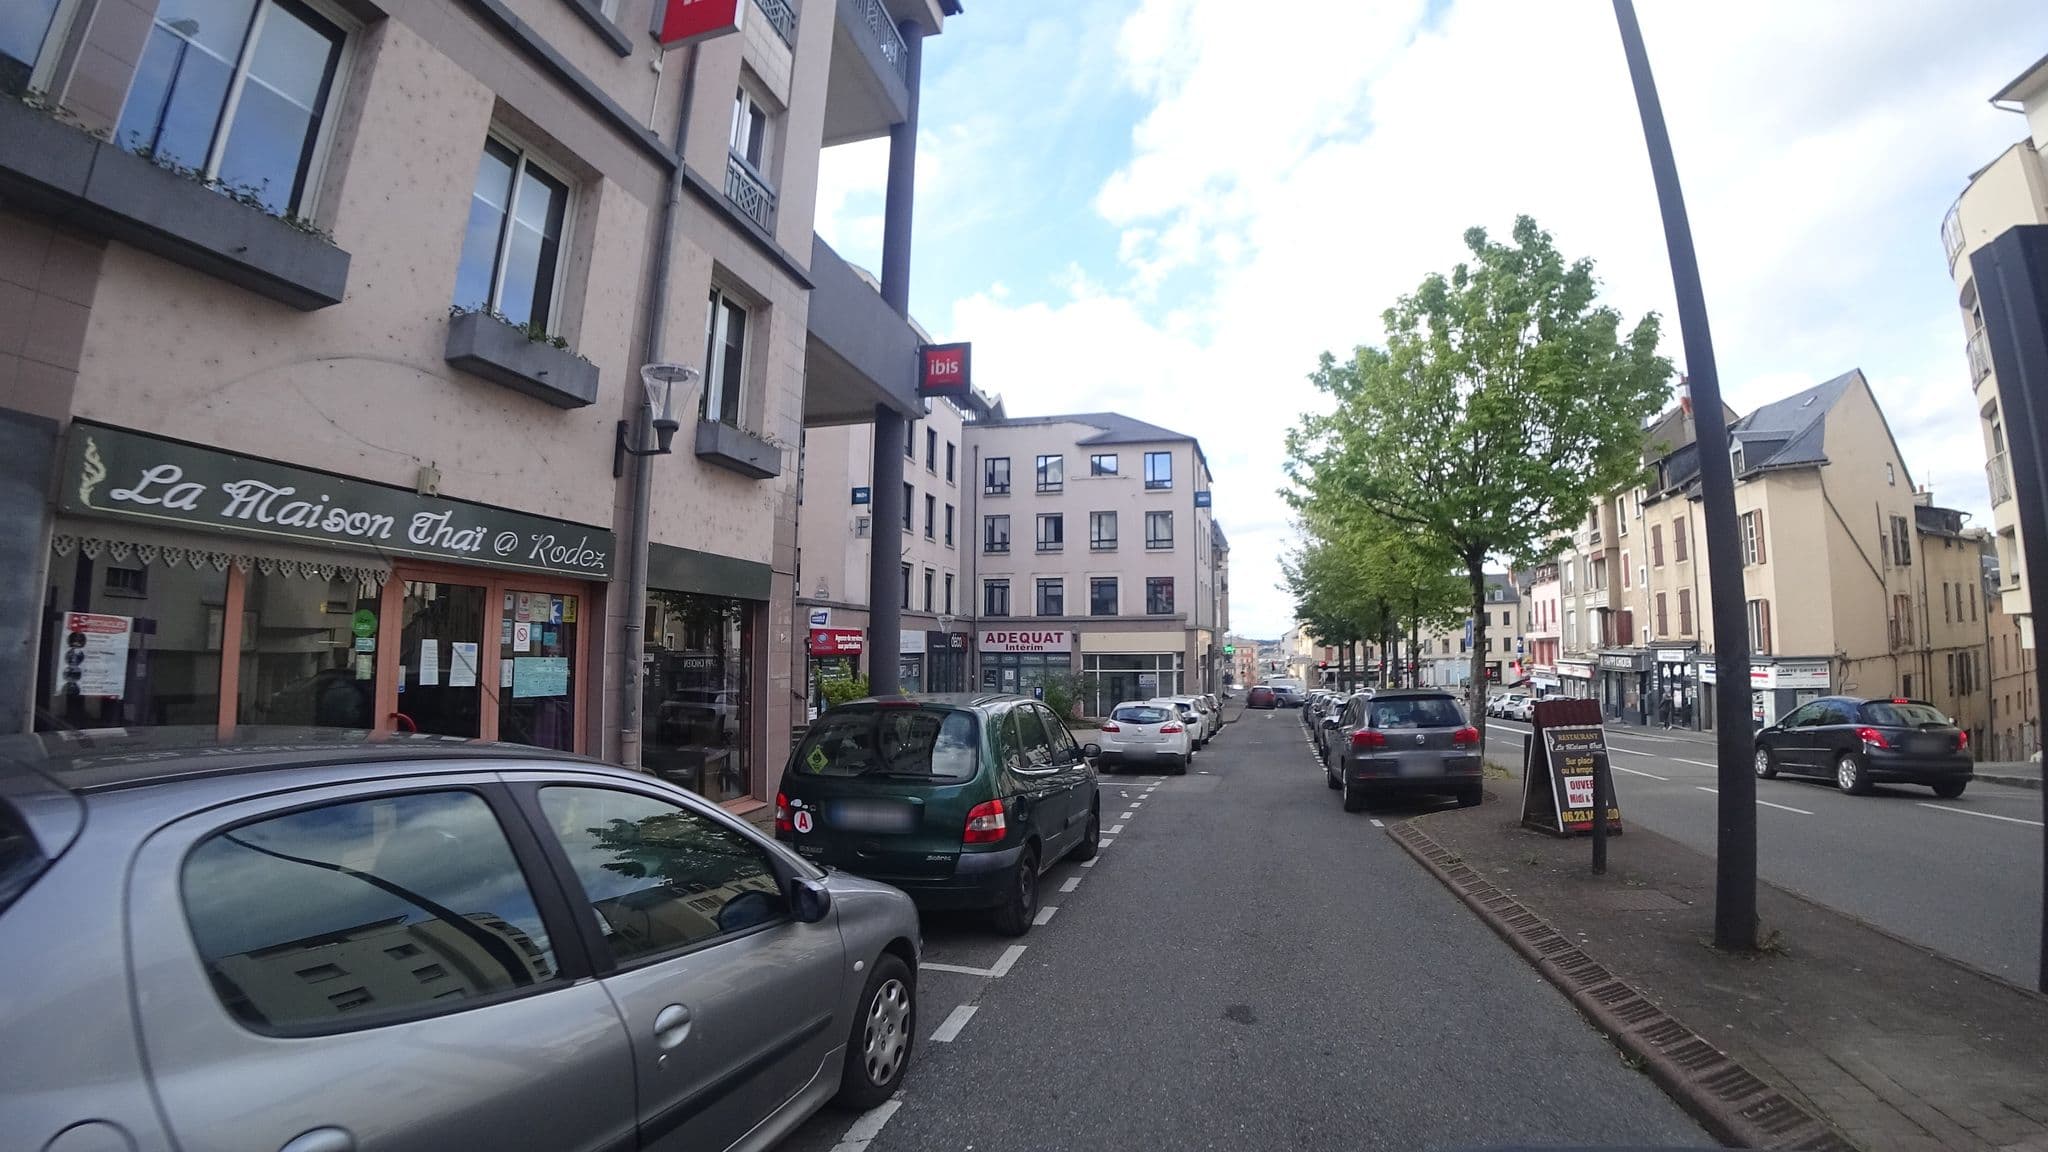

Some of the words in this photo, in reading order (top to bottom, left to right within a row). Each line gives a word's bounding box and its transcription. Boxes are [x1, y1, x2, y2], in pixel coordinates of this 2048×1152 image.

[930, 358, 959, 375] ibis
[110, 464, 207, 511] La
[220, 479, 395, 540] Maison
[408, 509, 487, 552] Thaï
[494, 531, 519, 556] @
[528, 534, 606, 569] Rodez
[985, 632, 1064, 644] ADEQUAT
[1558, 733, 1599, 741] RESTAURANT
[799, 813, 809, 830] A
